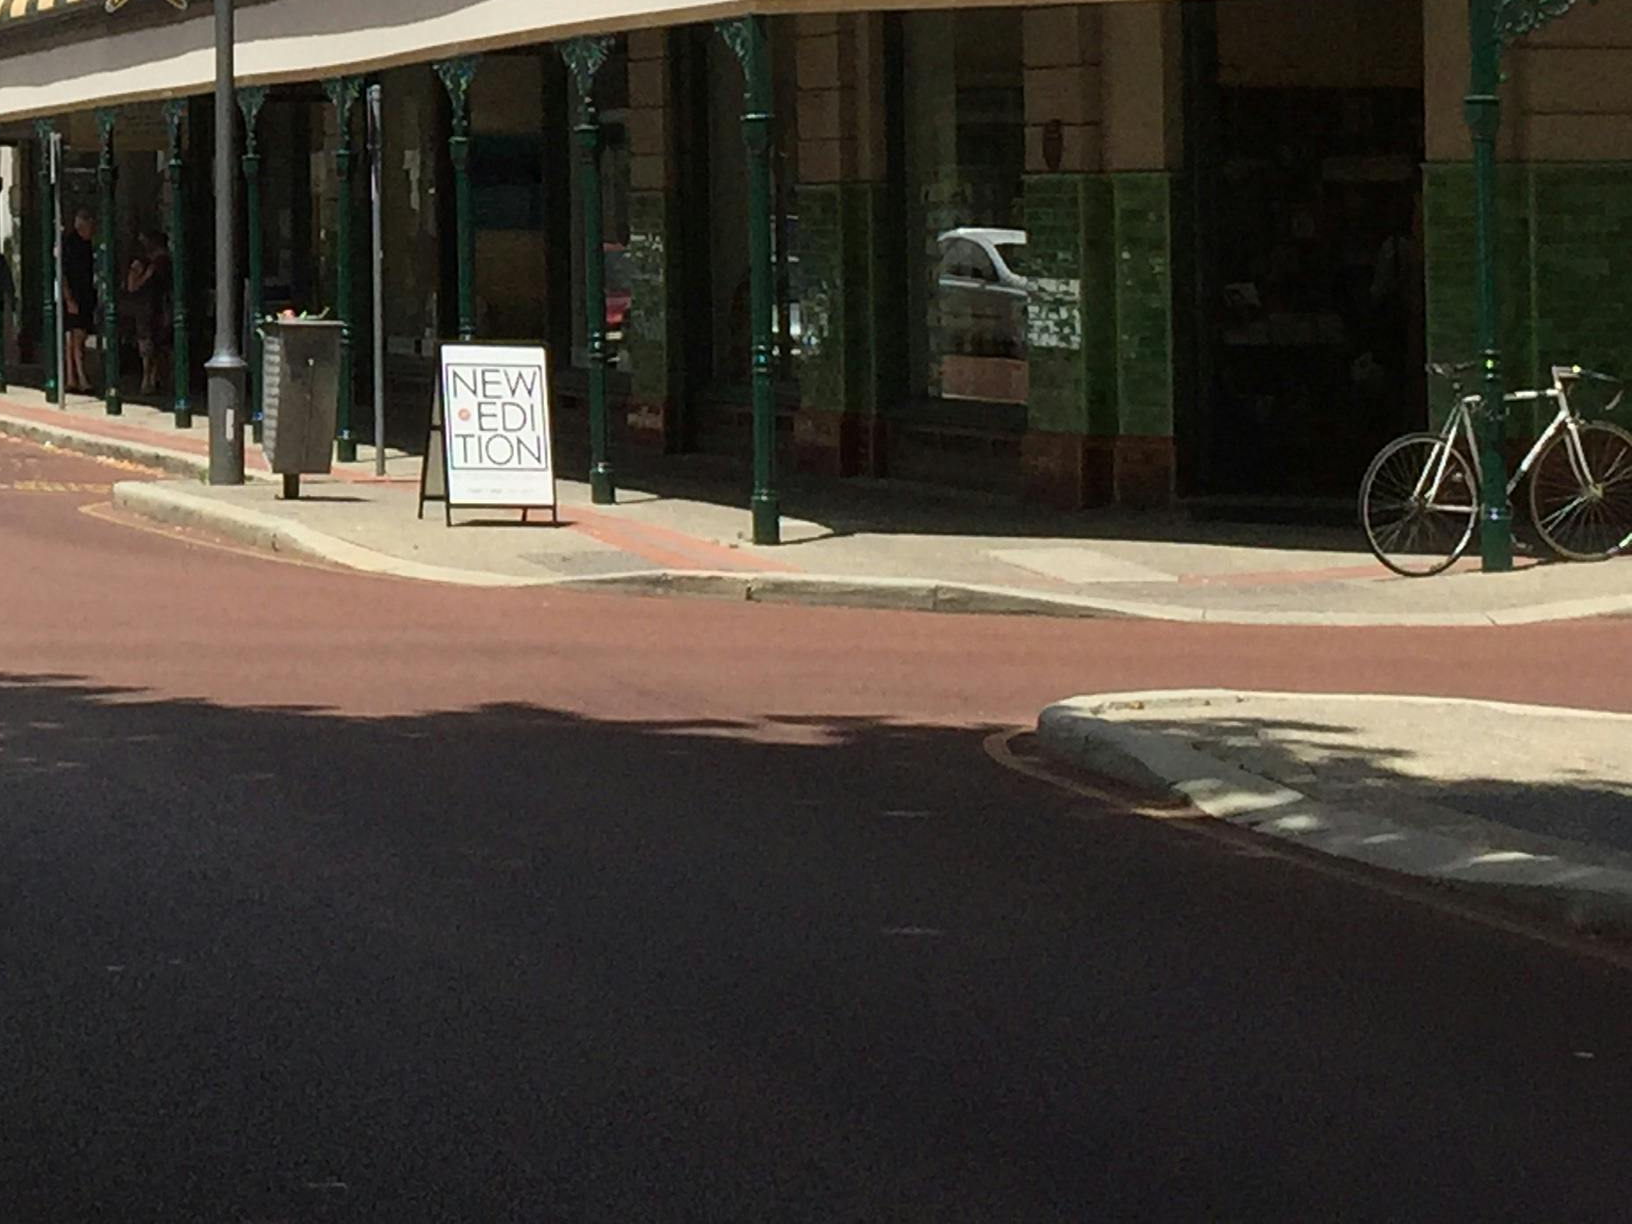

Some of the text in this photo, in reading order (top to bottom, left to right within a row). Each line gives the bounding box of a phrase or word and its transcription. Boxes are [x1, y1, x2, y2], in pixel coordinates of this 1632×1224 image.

[452, 368, 537, 399] NEW
[477, 401, 536, 432] EDI
[454, 433, 542, 466] TION
